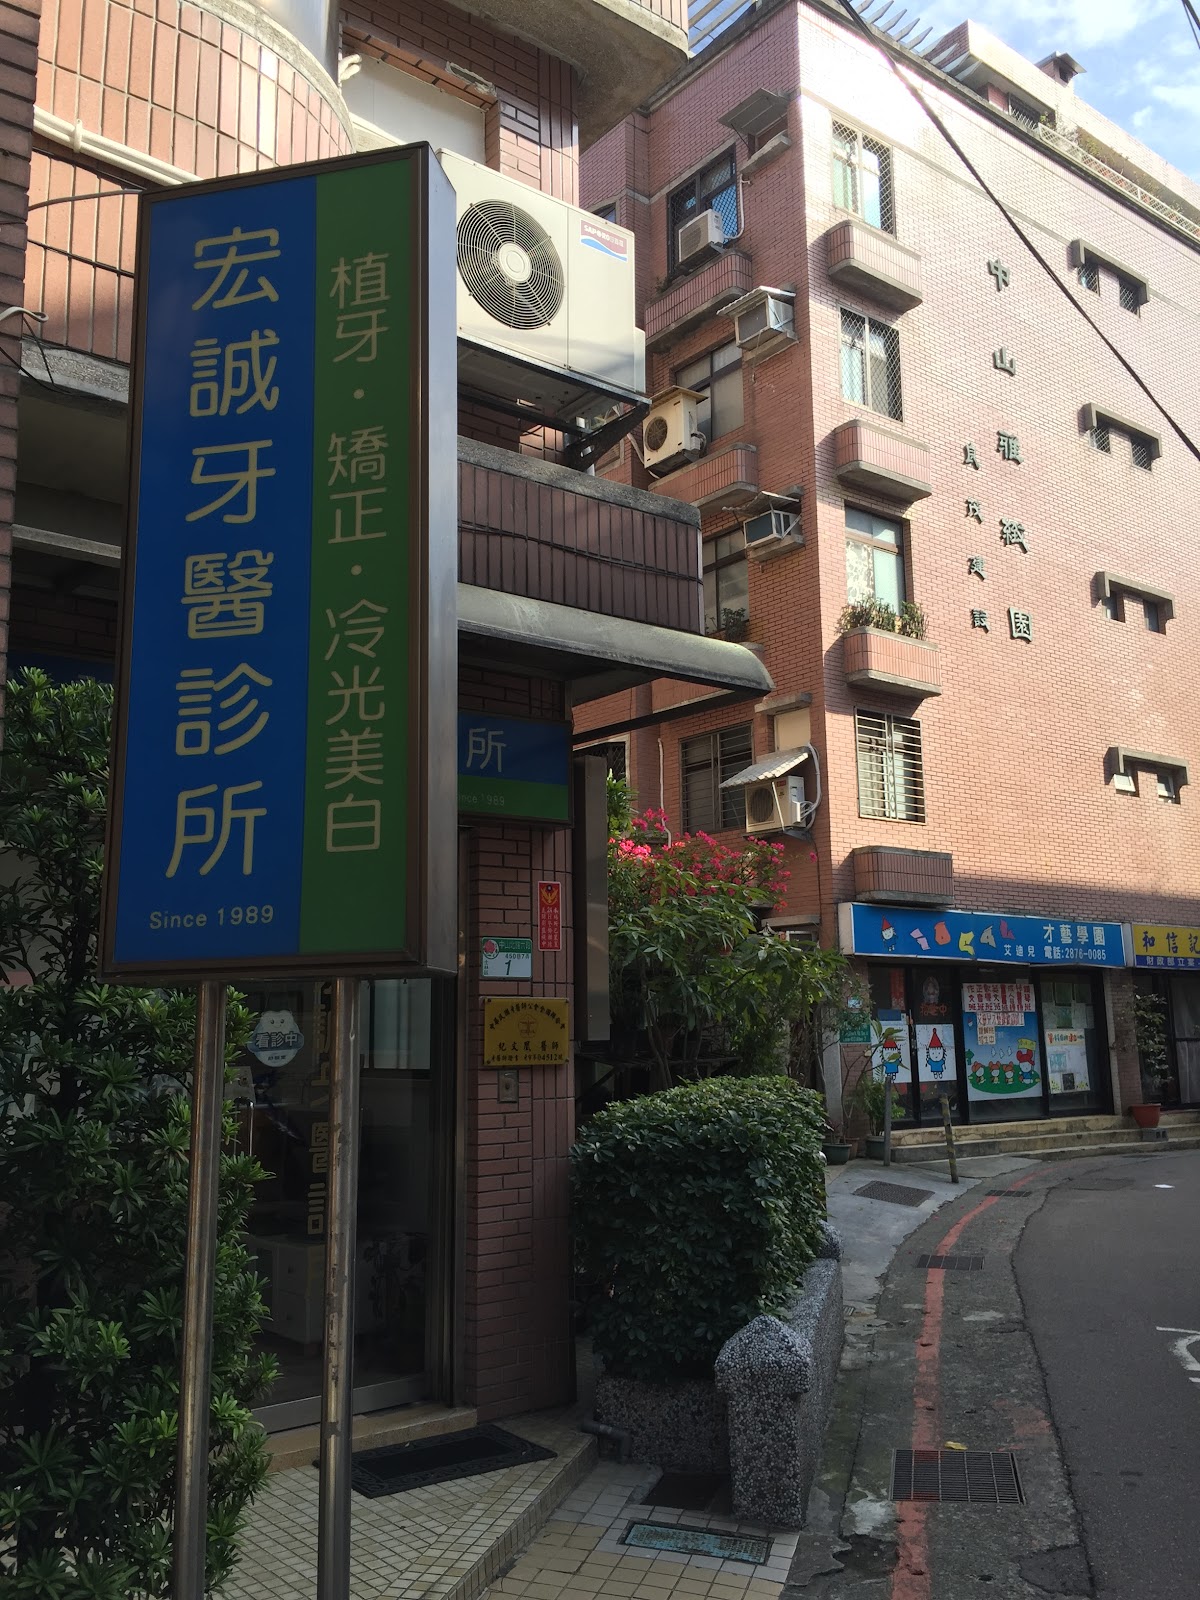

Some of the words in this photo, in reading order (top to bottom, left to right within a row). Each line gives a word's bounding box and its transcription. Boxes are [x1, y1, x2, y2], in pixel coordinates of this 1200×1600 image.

[165, 226, 281, 878] 宏誠牙醫診所
[466, 727, 507, 773] 所
[149, 912, 207, 930] Since
[217, 905, 275, 927] 1989
[1042, 923, 1106, 946] 才藝學園
[1003, 944, 1036, 958] 艾迪兒
[505, 959, 511, 976] 1
[1146, 956, 1200, 967] 財政部立案
[256, 1032, 298, 1048] 看診中
